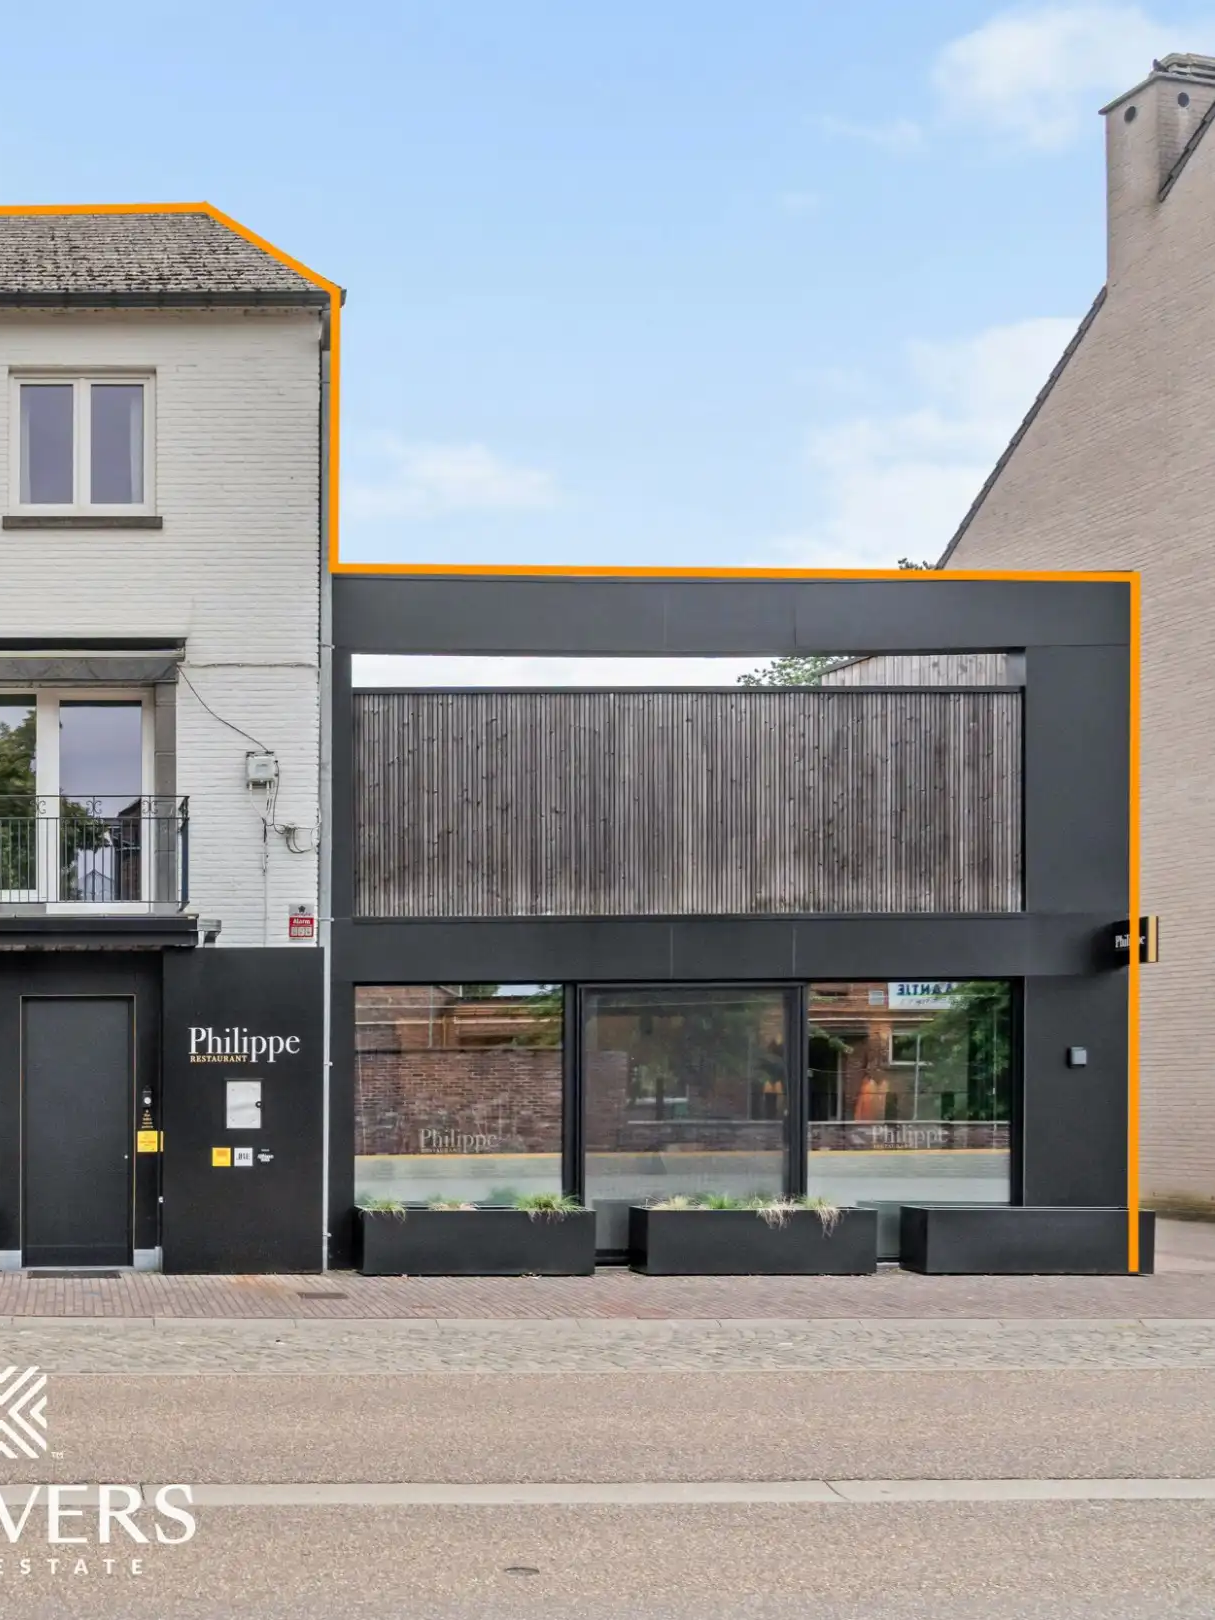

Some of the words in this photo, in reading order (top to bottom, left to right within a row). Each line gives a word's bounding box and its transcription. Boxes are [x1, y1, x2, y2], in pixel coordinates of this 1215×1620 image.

[1115, 934, 1146, 948] Phile
[188, 1027, 301, 1063] Philippe
[190, 1055, 248, 1063] RESTAURANT
[418, 1128, 499, 1153] Philippe
[872, 1125, 949, 1148] Philippe
